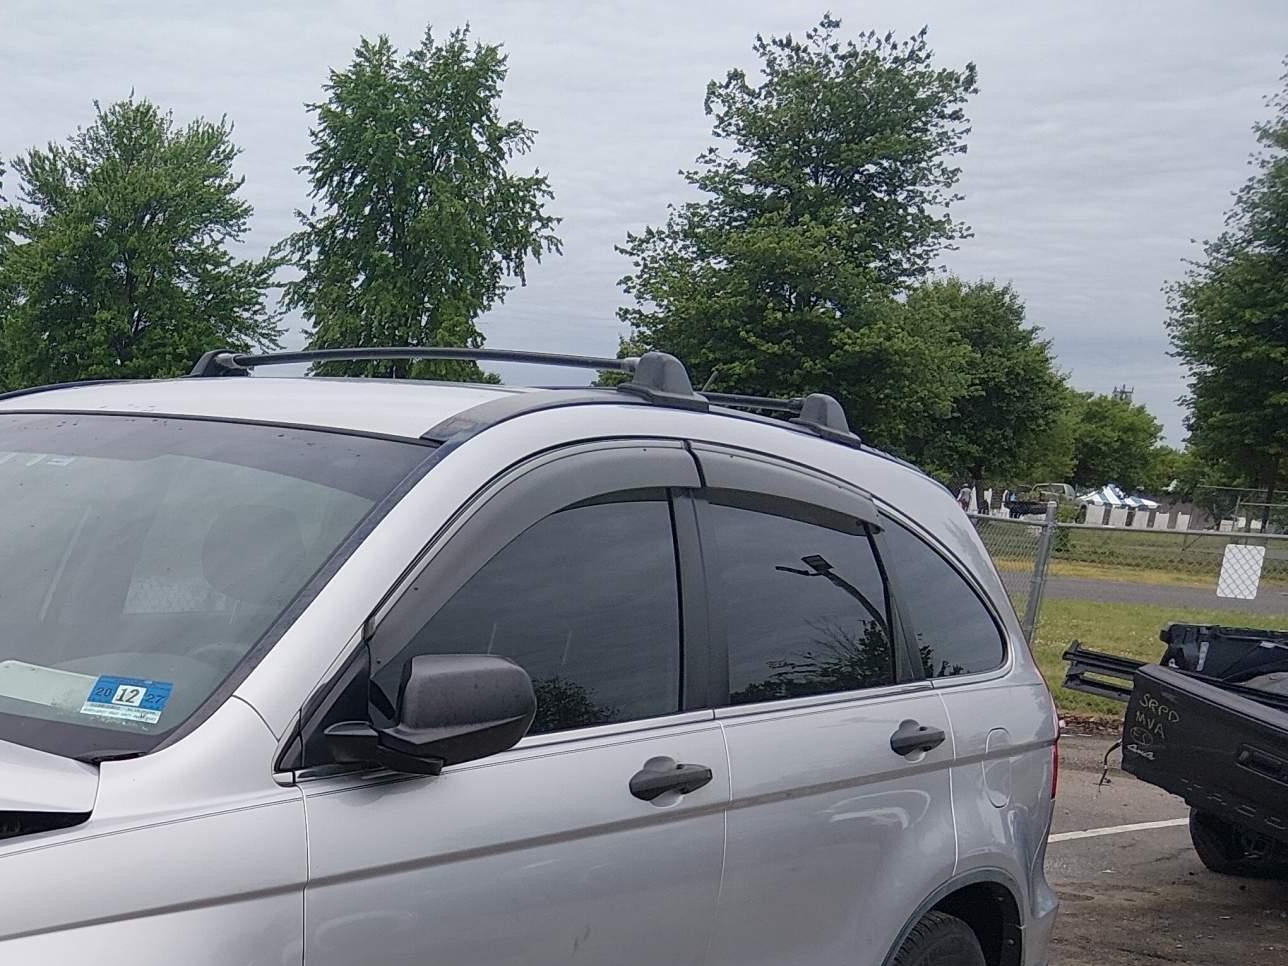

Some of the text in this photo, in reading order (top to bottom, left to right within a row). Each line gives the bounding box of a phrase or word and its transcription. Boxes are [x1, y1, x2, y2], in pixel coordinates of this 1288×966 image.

[95, 687, 165, 704] 20 12 27
[1136, 711, 1165, 739] MVA
